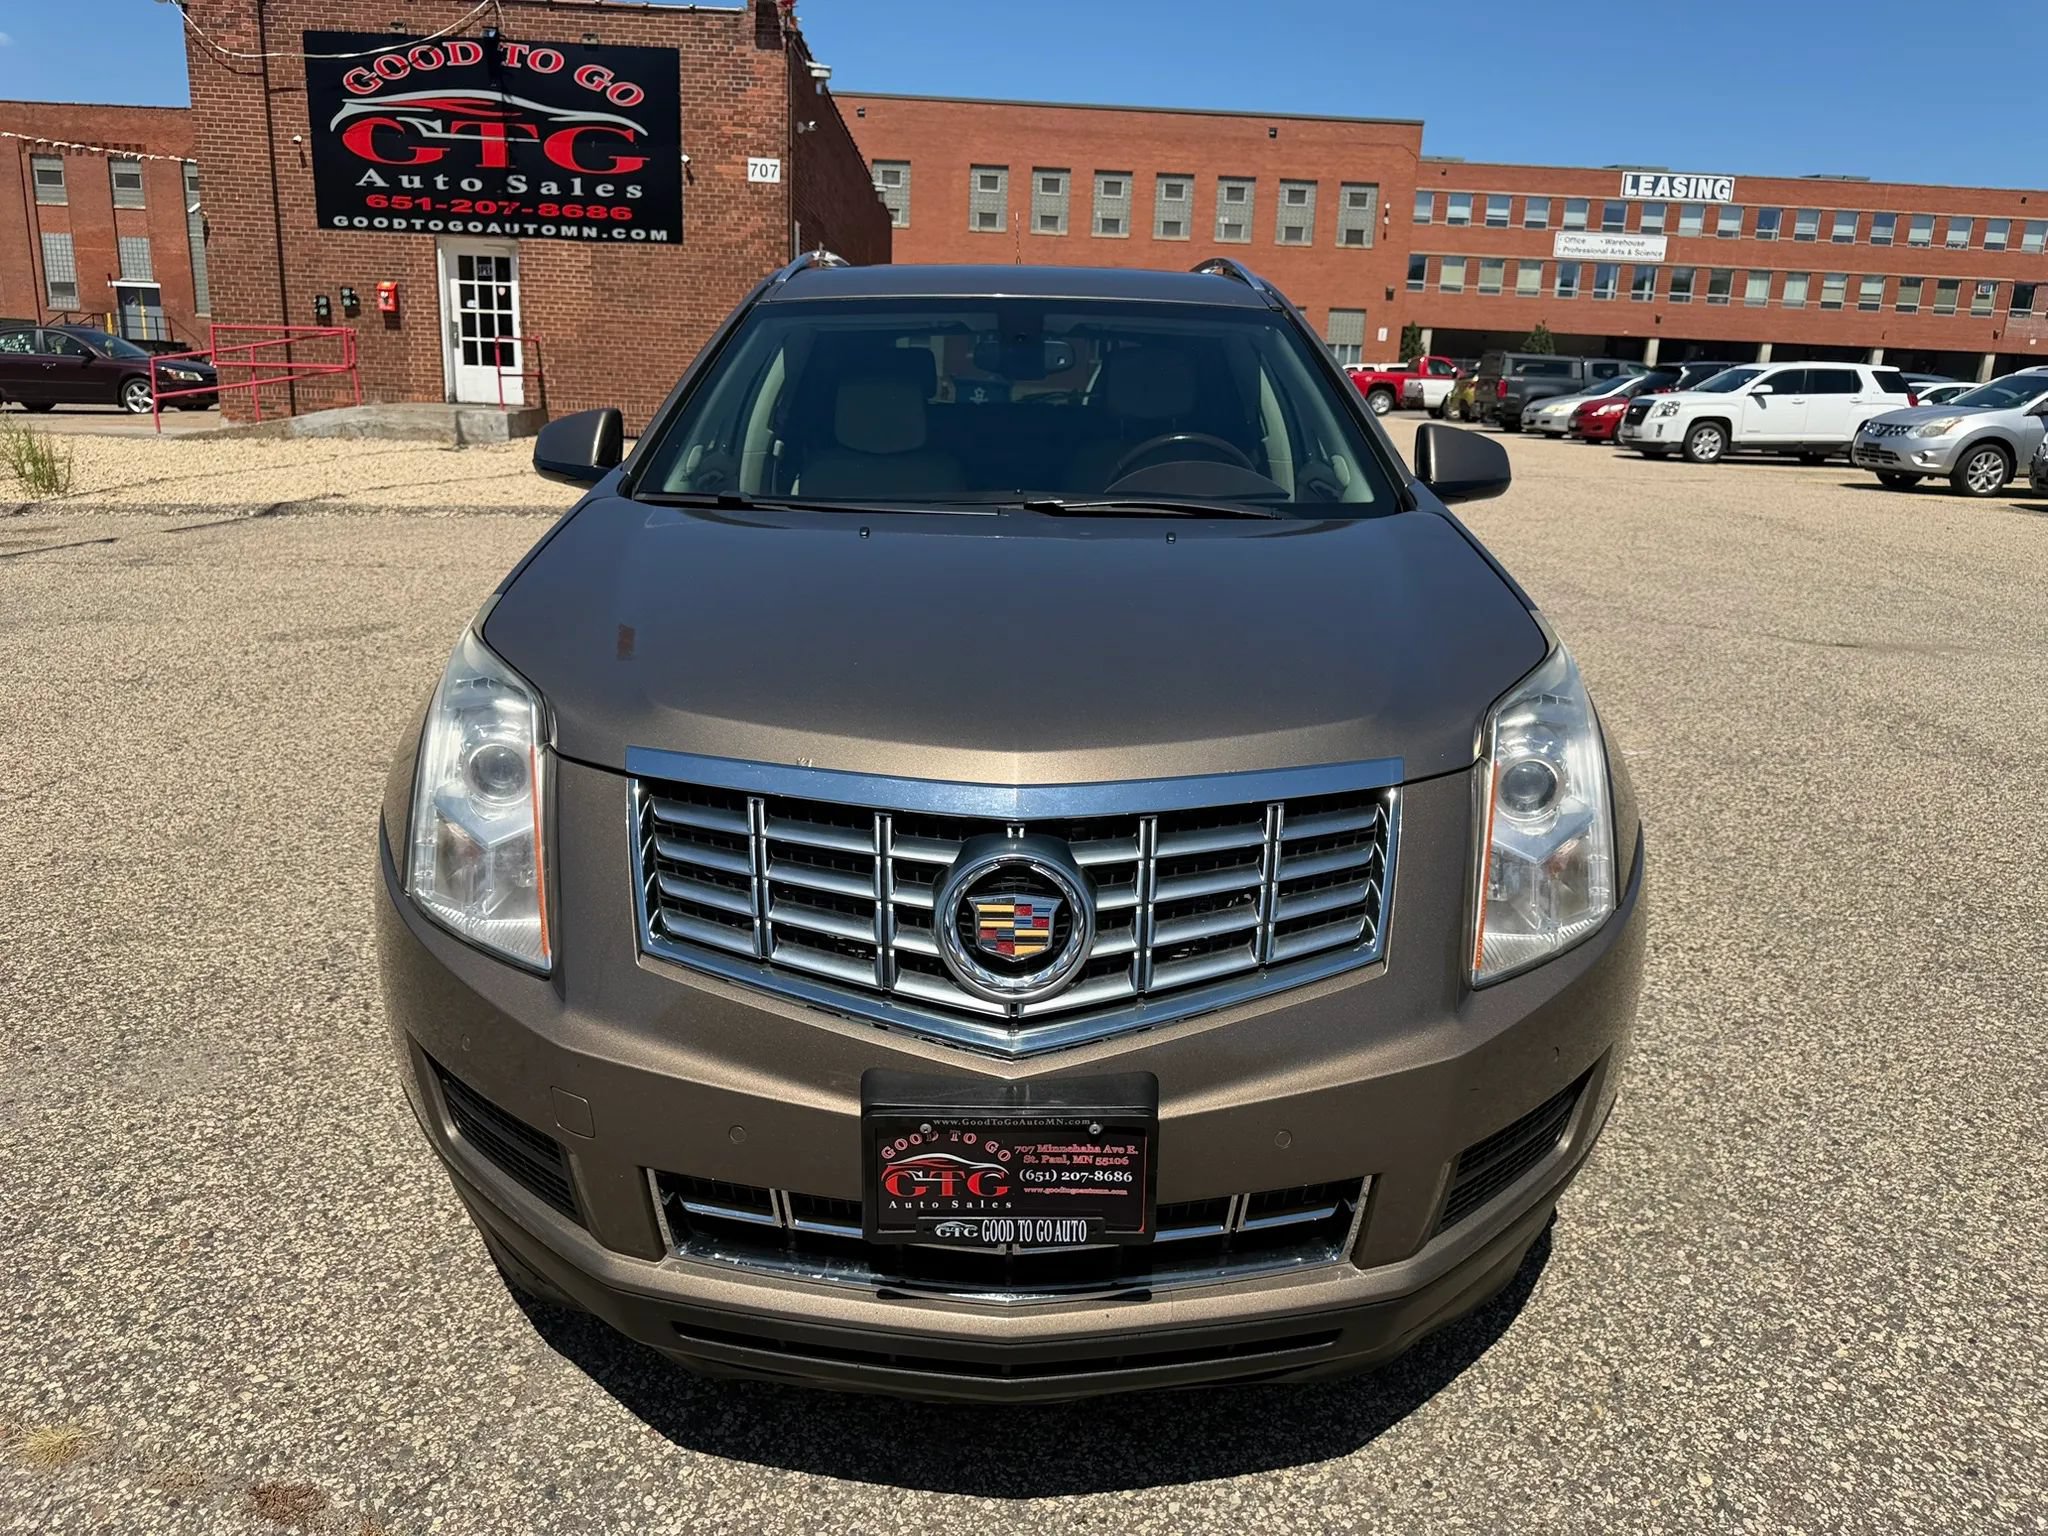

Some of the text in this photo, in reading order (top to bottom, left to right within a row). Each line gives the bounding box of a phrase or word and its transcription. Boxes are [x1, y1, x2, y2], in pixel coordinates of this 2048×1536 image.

[343, 41, 645, 107] GOOD TO GO
[342, 117, 650, 175] GTG
[750, 163, 778, 179] 707
[355, 168, 643, 199] Auto Sales
[1624, 175, 1731, 200] LEASING
[366, 194, 633, 221] 651-207-8686
[333, 215, 668, 241] GOODTOGOAUTOMN.COM
[1562, 246, 1609, 255] Professional
[1610, 248, 1625, 256] Arts
[1634, 249, 1663, 257] Science
[1564, 236, 1646, 247] Office Warehouse
[932, 1118, 1091, 1126] www.GoodToGoAutoMN.com
[881, 1130, 1011, 1161] GOOD TO GO
[1014, 1144, 1138, 1155] 707 Minnehaha Ave E.
[1023, 1155, 1129, 1166] St. Paul, MN 55106
[885, 1170, 1012, 1197] GTG
[1019, 1168, 1133, 1183] (651) 207-8686
[889, 1200, 1012, 1209] Auto Sales
[982, 1219, 1015, 1242] GOOD
[1018, 1219, 1033, 1242] TO
[1036, 1219, 1053, 1242] GO
[1054, 1219, 1088, 1242] AUTO
